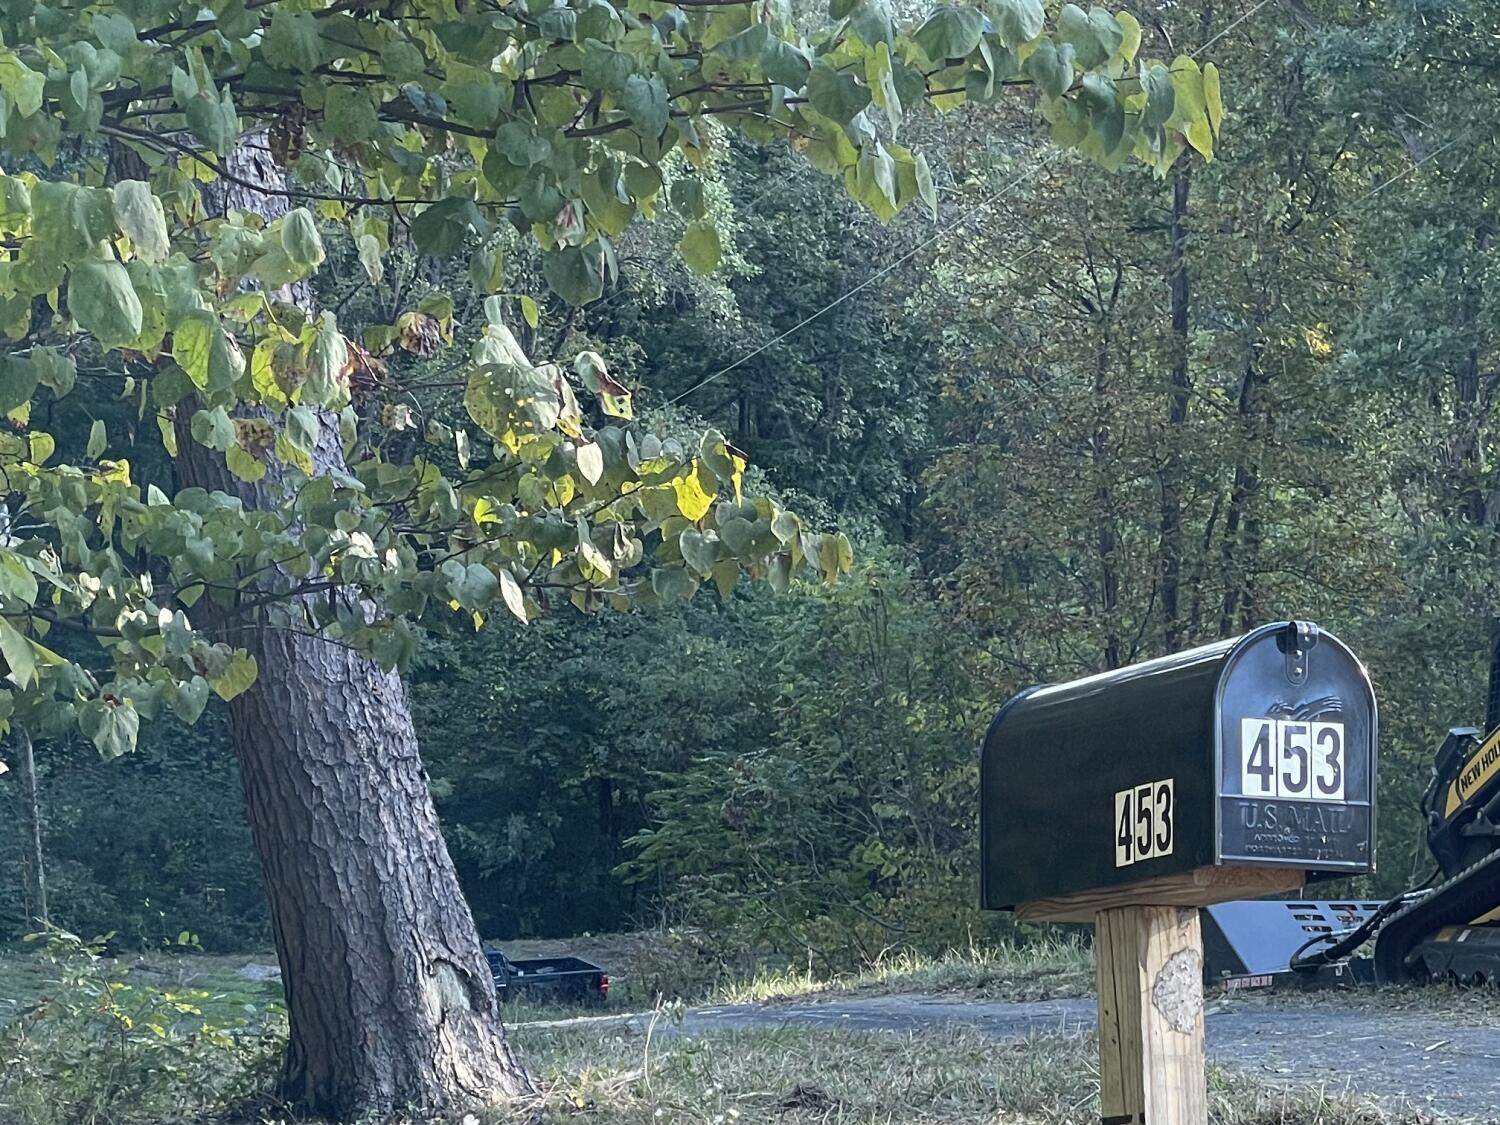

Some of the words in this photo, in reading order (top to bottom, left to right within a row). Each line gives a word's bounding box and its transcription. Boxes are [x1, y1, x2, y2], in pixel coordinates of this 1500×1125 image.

[1246, 724, 1341, 795] 453
[1461, 762, 1480, 792] NEW
[1118, 784, 1171, 862] 453
